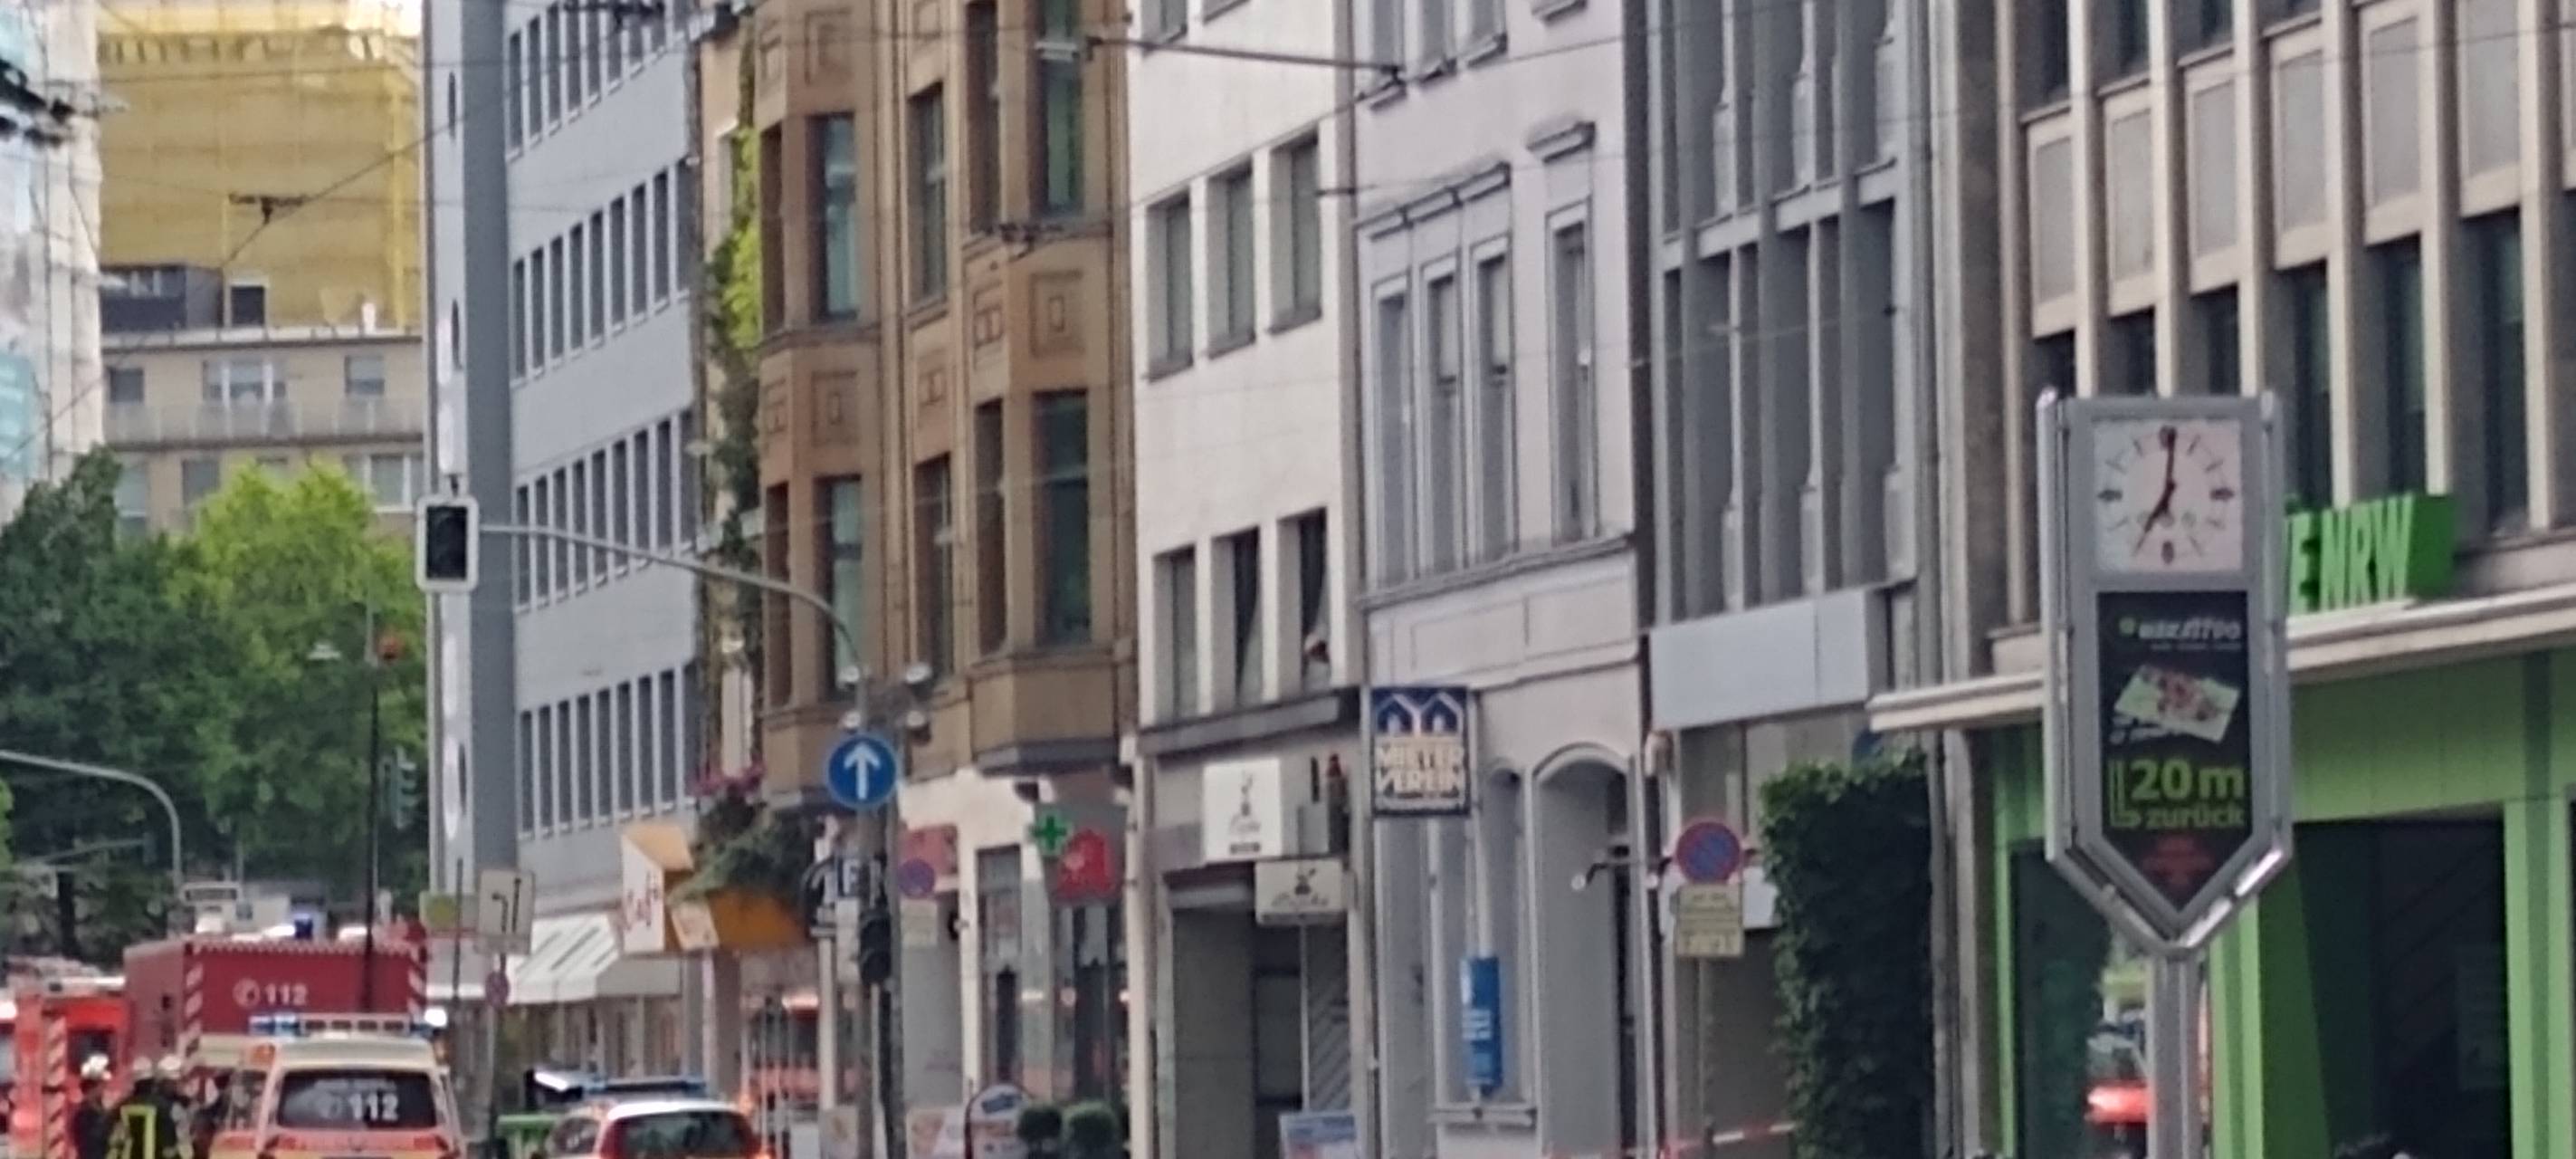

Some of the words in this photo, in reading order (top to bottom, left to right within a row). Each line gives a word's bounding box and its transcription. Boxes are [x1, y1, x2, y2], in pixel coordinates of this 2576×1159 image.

[2320, 492, 2414, 614] NRW
[1375, 741, 1465, 769] MIETER
[1375, 766, 1465, 798] VEREIN
[2130, 757, 2192, 801] 20
[2198, 767, 2246, 800] m
[2145, 802, 2246, 829] zurück
[264, 982, 308, 1006] 112
[348, 1091, 398, 1122] 112
